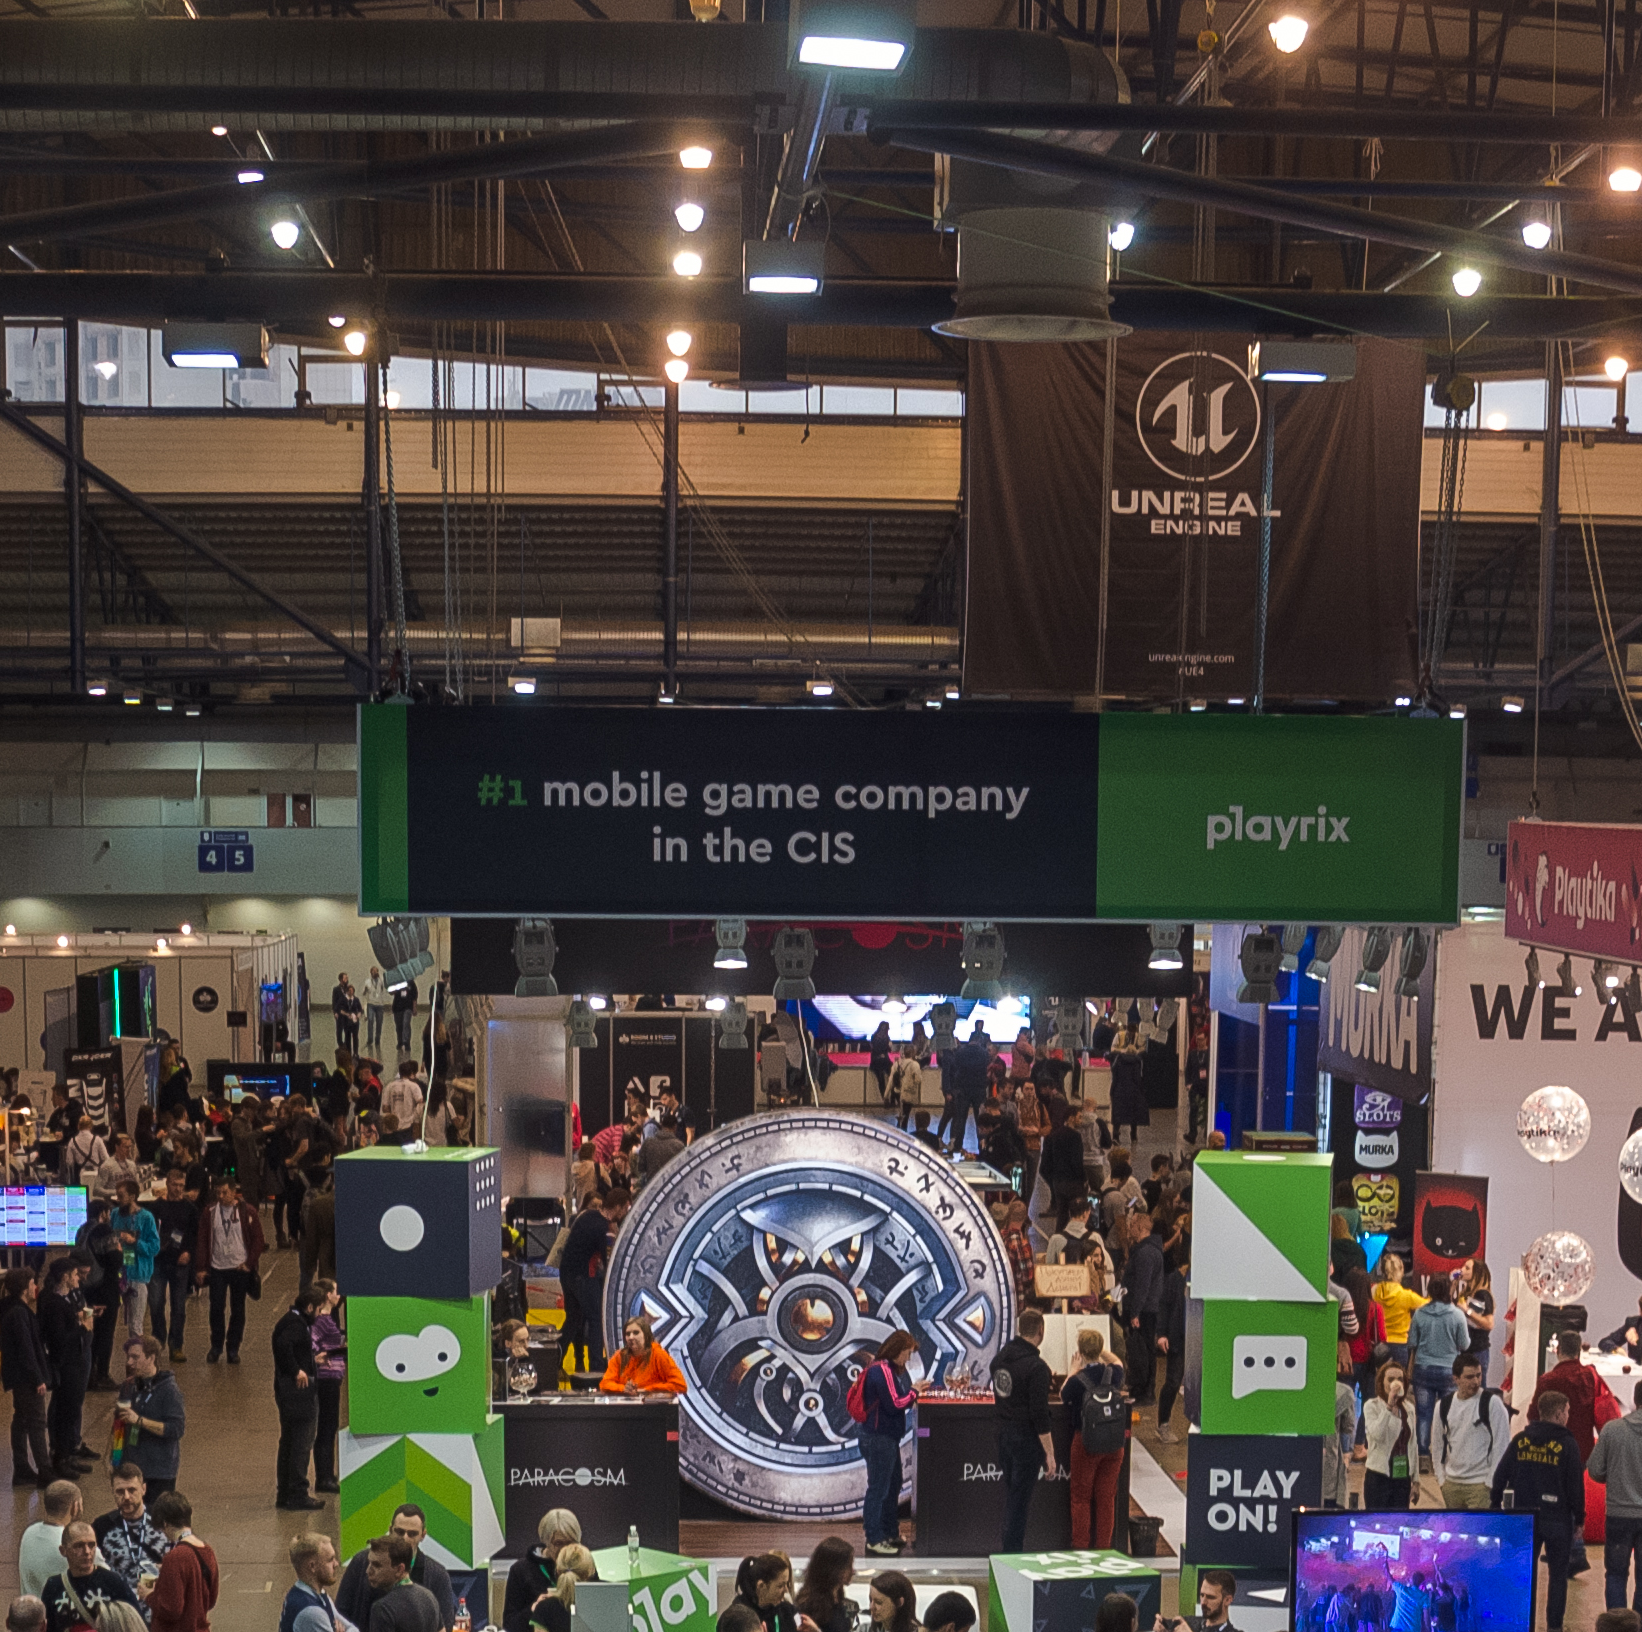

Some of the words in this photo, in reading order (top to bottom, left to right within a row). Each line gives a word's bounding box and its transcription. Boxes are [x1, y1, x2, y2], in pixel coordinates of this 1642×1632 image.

[1111, 489, 1282, 518] UNREAL
[1150, 519, 1242, 536] ENGINE
[478, 773, 528, 807] #1
[543, 771, 688, 808] mobile
[702, 781, 819, 816] game
[834, 782, 1031, 820] company
[1205, 803, 1351, 851] playrix
[206, 850, 217, 865] 4
[234, 850, 245, 865] 5
[652, 825, 688, 863] in
[702, 827, 772, 864] the
[786, 831, 856, 864] CIS
[1554, 865, 1616, 928] Playtika
[1470, 984, 1579, 1041] WE
[1356, 1109, 1401, 1123] SLOTS
[1358, 1144, 1395, 1156] MURKA
[510, 1467, 626, 1487] PARACOSM
[1208, 1468, 1299, 1498] PLAY
[1207, 1504, 1277, 1533] ON!
